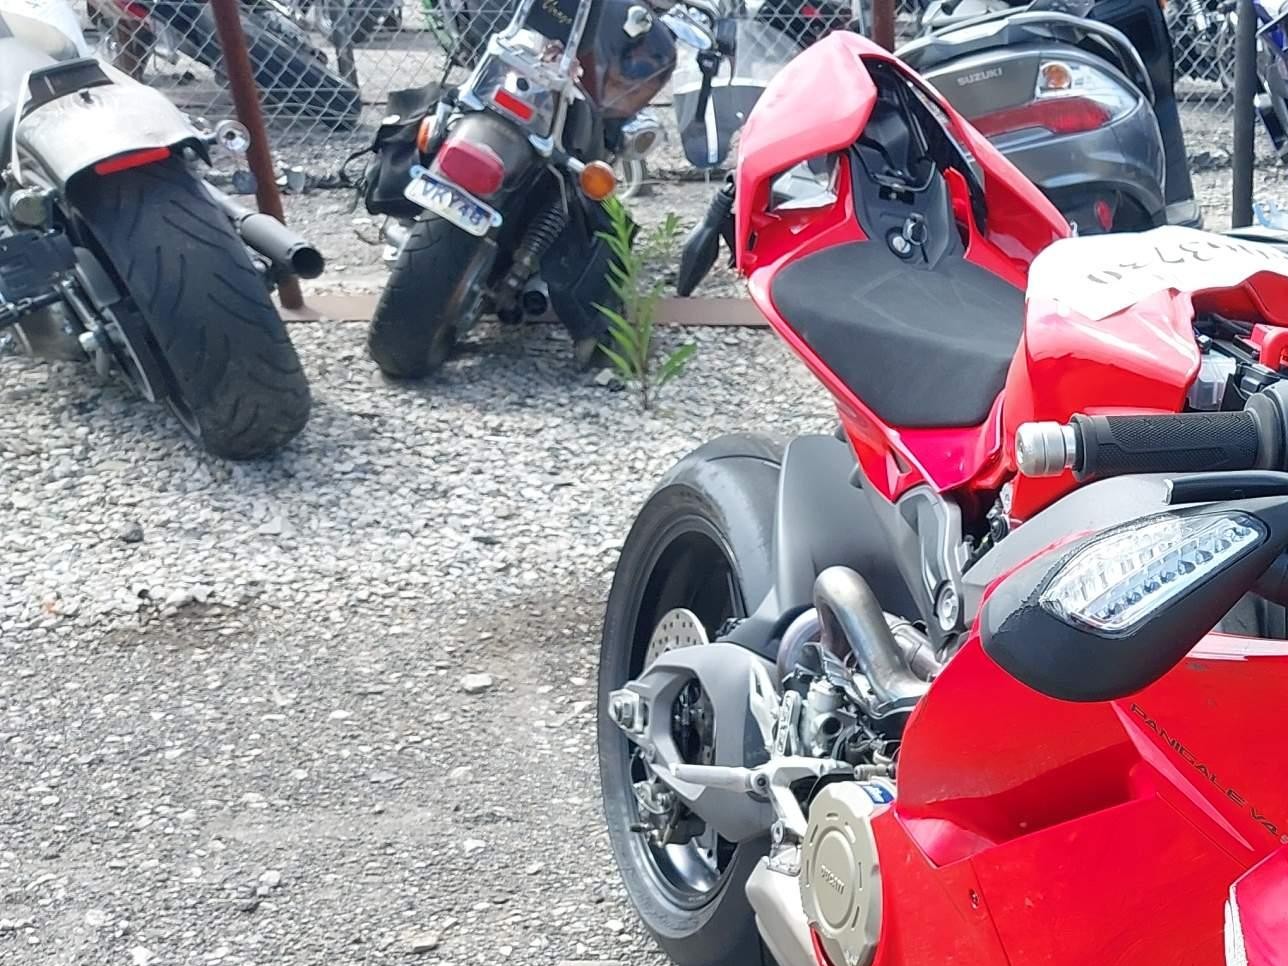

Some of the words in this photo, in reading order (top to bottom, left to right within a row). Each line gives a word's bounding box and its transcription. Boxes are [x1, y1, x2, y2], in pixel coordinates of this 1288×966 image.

[957, 67, 1003, 87] SUZUKI
[1131, 703, 1247, 808] PANIGALE
[1250, 807, 1280, 837] V4
